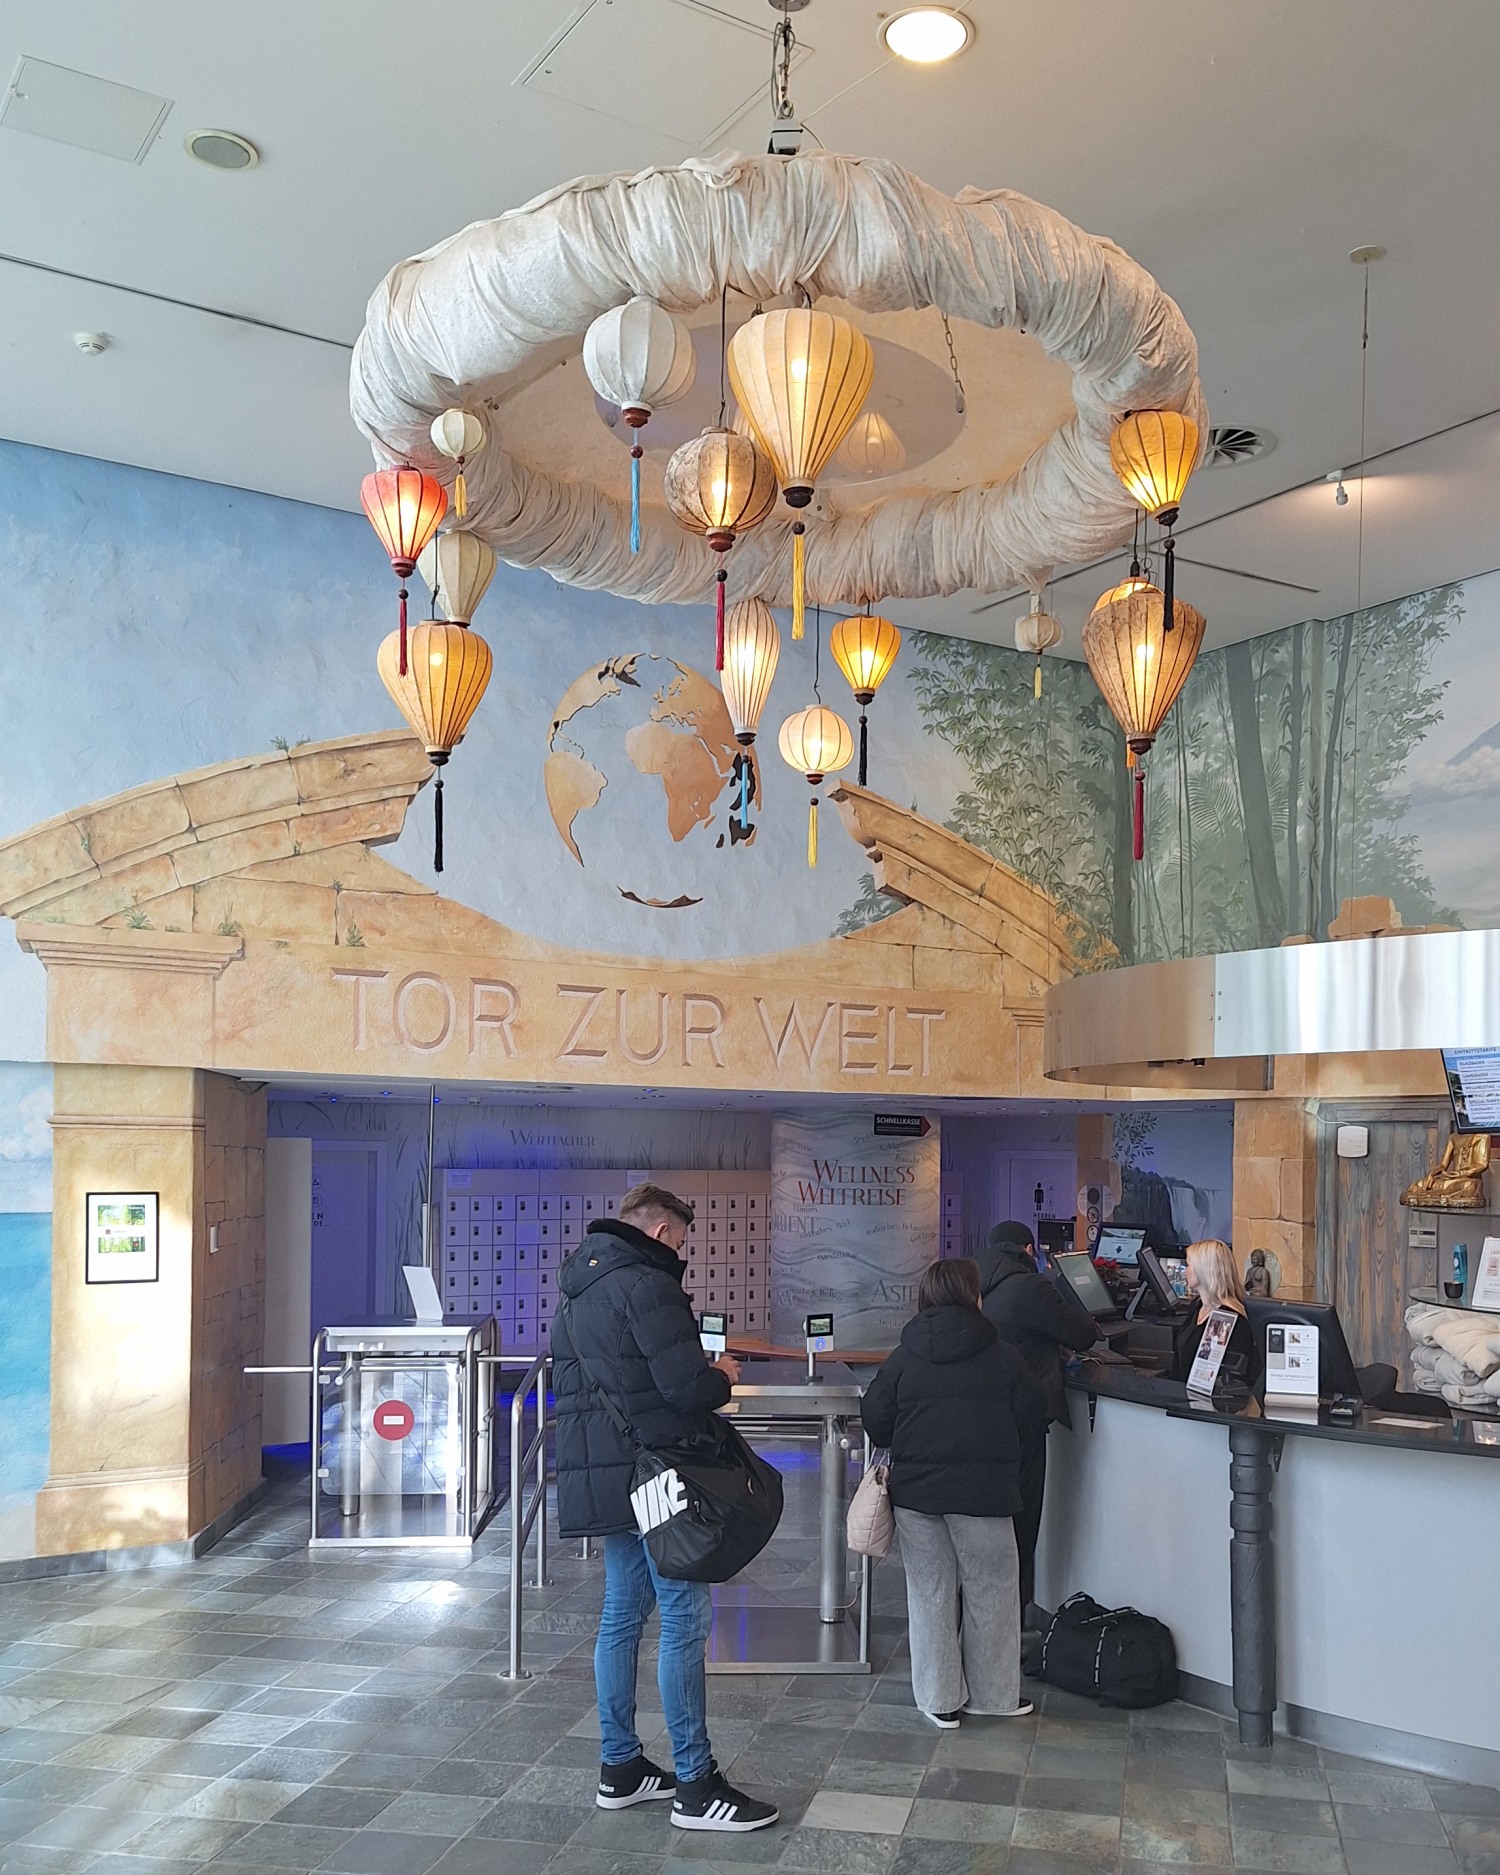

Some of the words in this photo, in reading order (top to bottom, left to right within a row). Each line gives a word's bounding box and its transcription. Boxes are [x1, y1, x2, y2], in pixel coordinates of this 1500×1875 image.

[331, 967, 522, 1059] TOR
[555, 984, 726, 1068] ZUR
[753, 997, 946, 1077] WELT
[876, 1116, 921, 1126] SCHNELLKASSE
[812, 1159, 915, 1184] WELLNESS
[797, 1181, 907, 1206] WELTREISE
[870, 1279, 919, 1302] ASIE
[630, 1468, 688, 1535] NIKE
